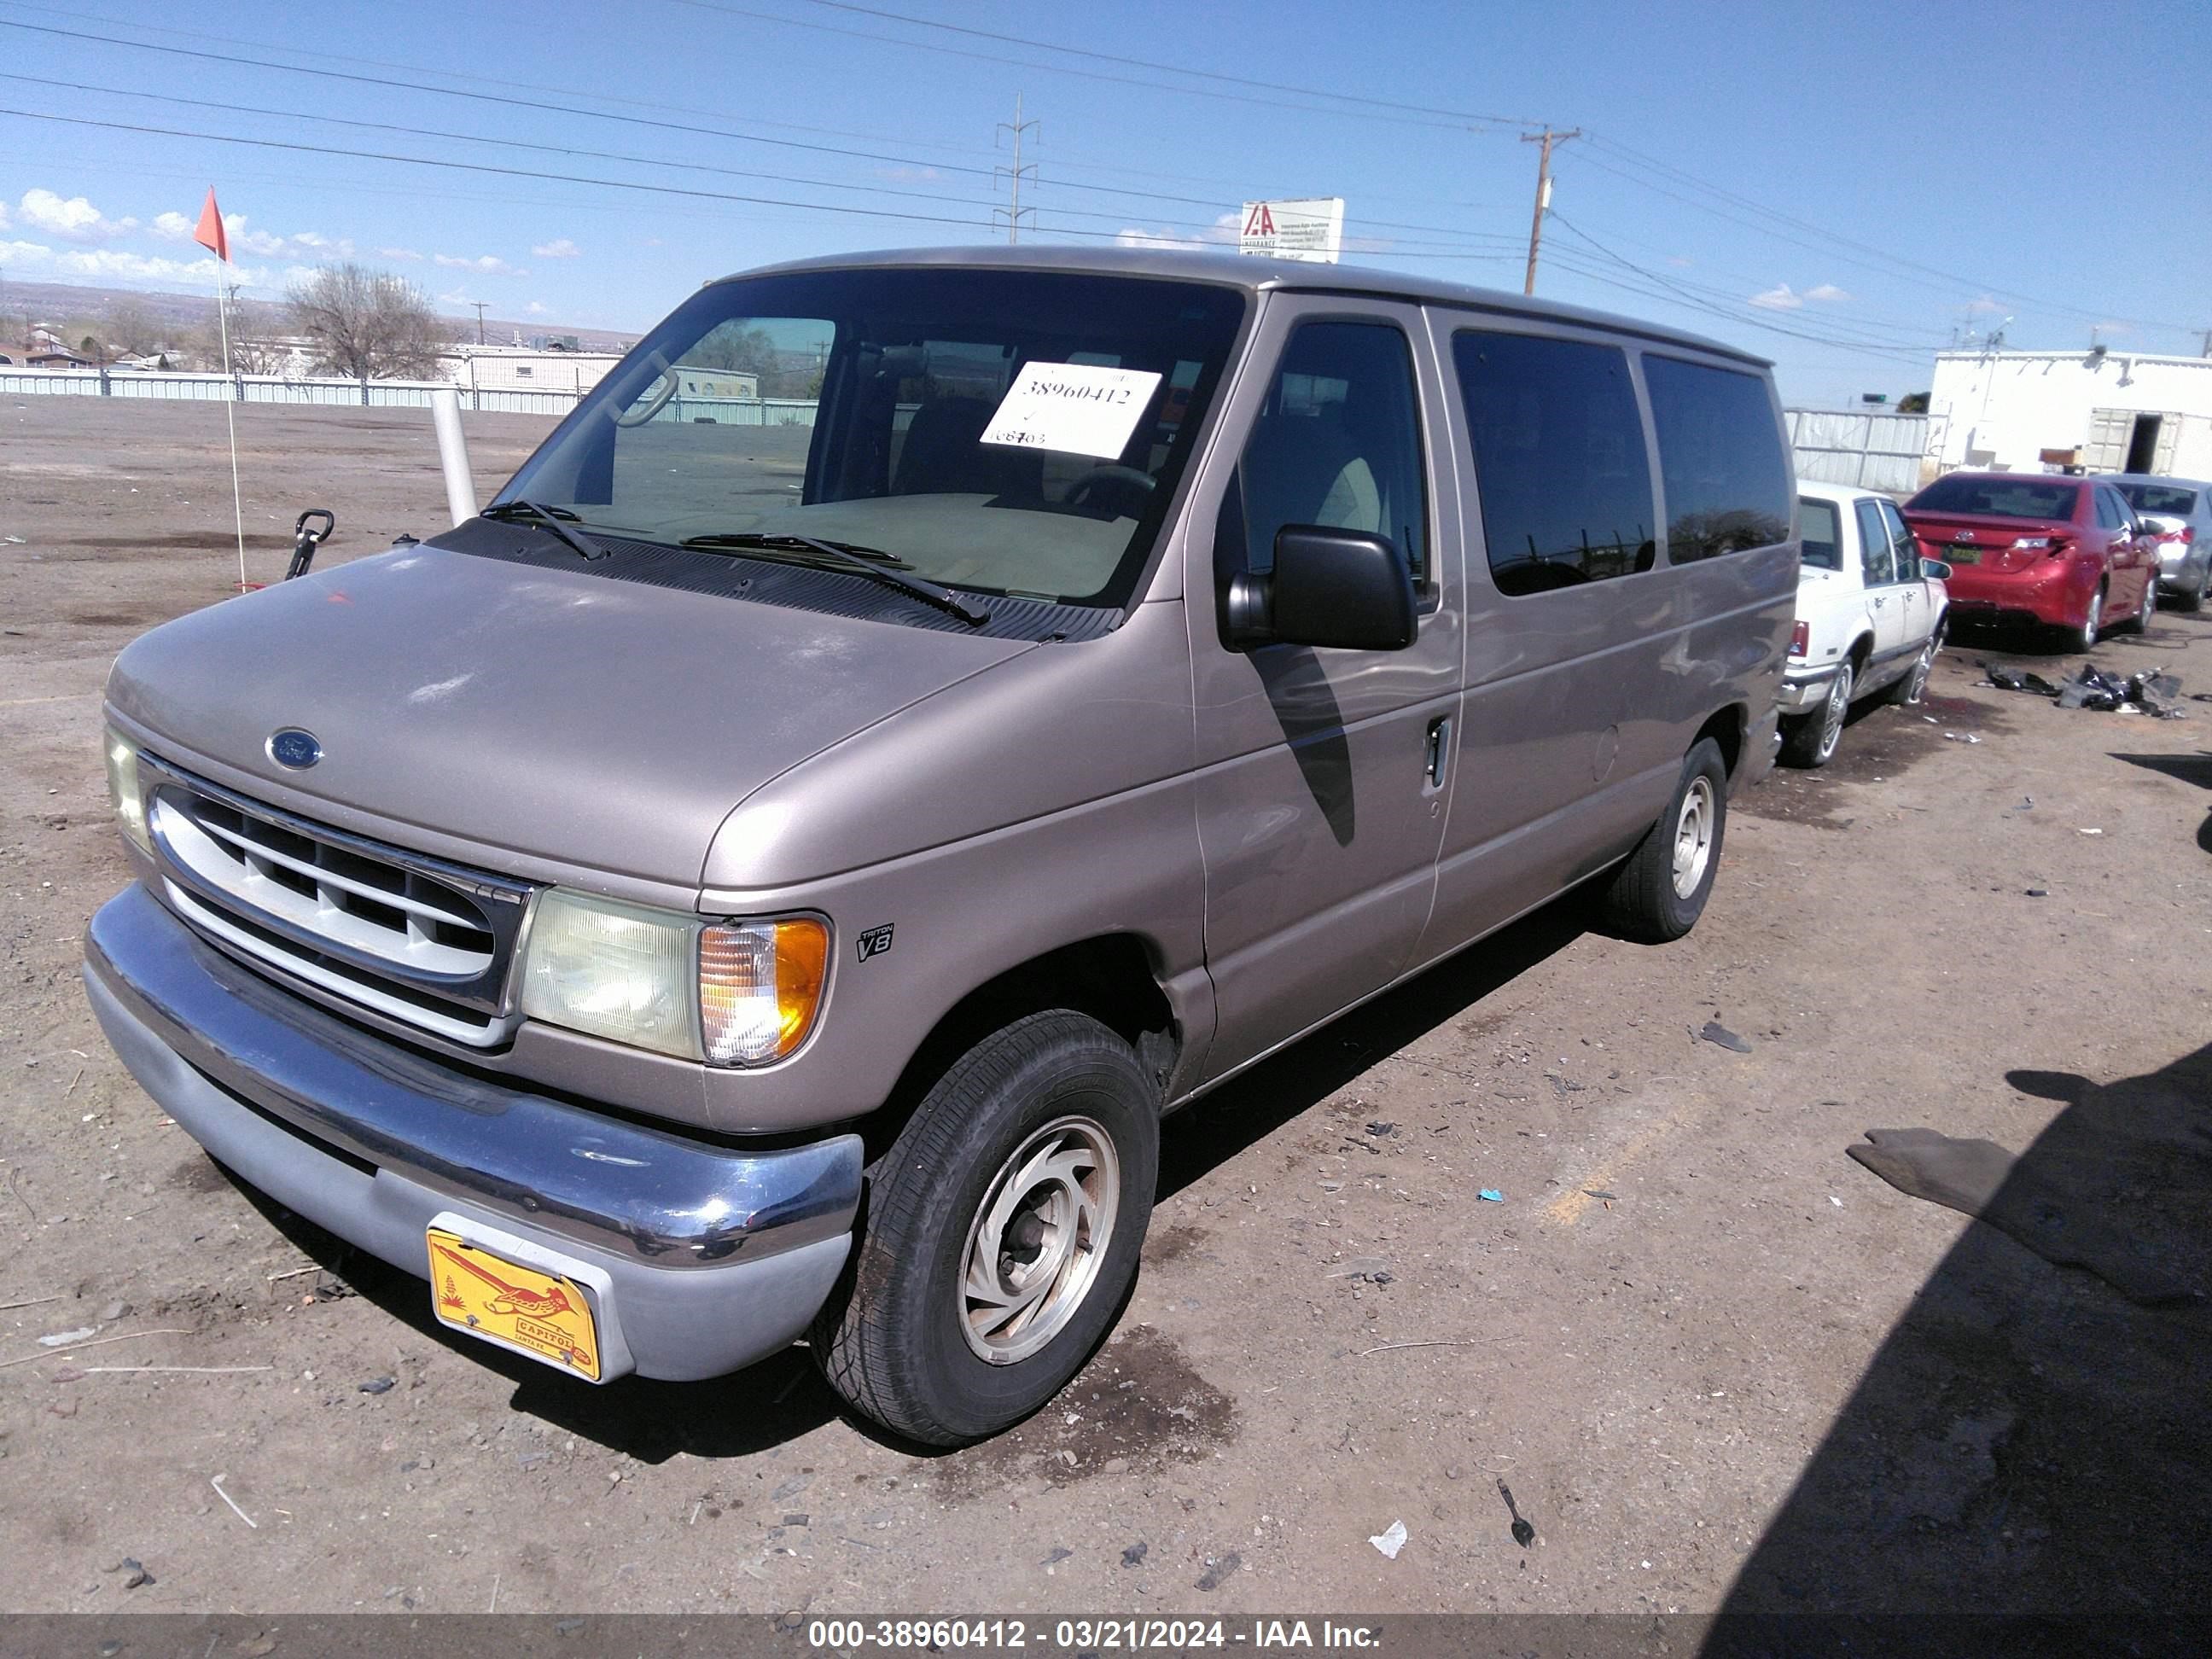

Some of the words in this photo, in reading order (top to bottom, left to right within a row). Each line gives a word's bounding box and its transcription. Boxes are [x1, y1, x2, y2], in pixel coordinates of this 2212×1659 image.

[1022, 381, 1131, 405] 38960412
[858, 934, 891, 961] V8
[515, 1333, 536, 1347] SANTA
[520, 1321, 572, 1348] CAPITOL
